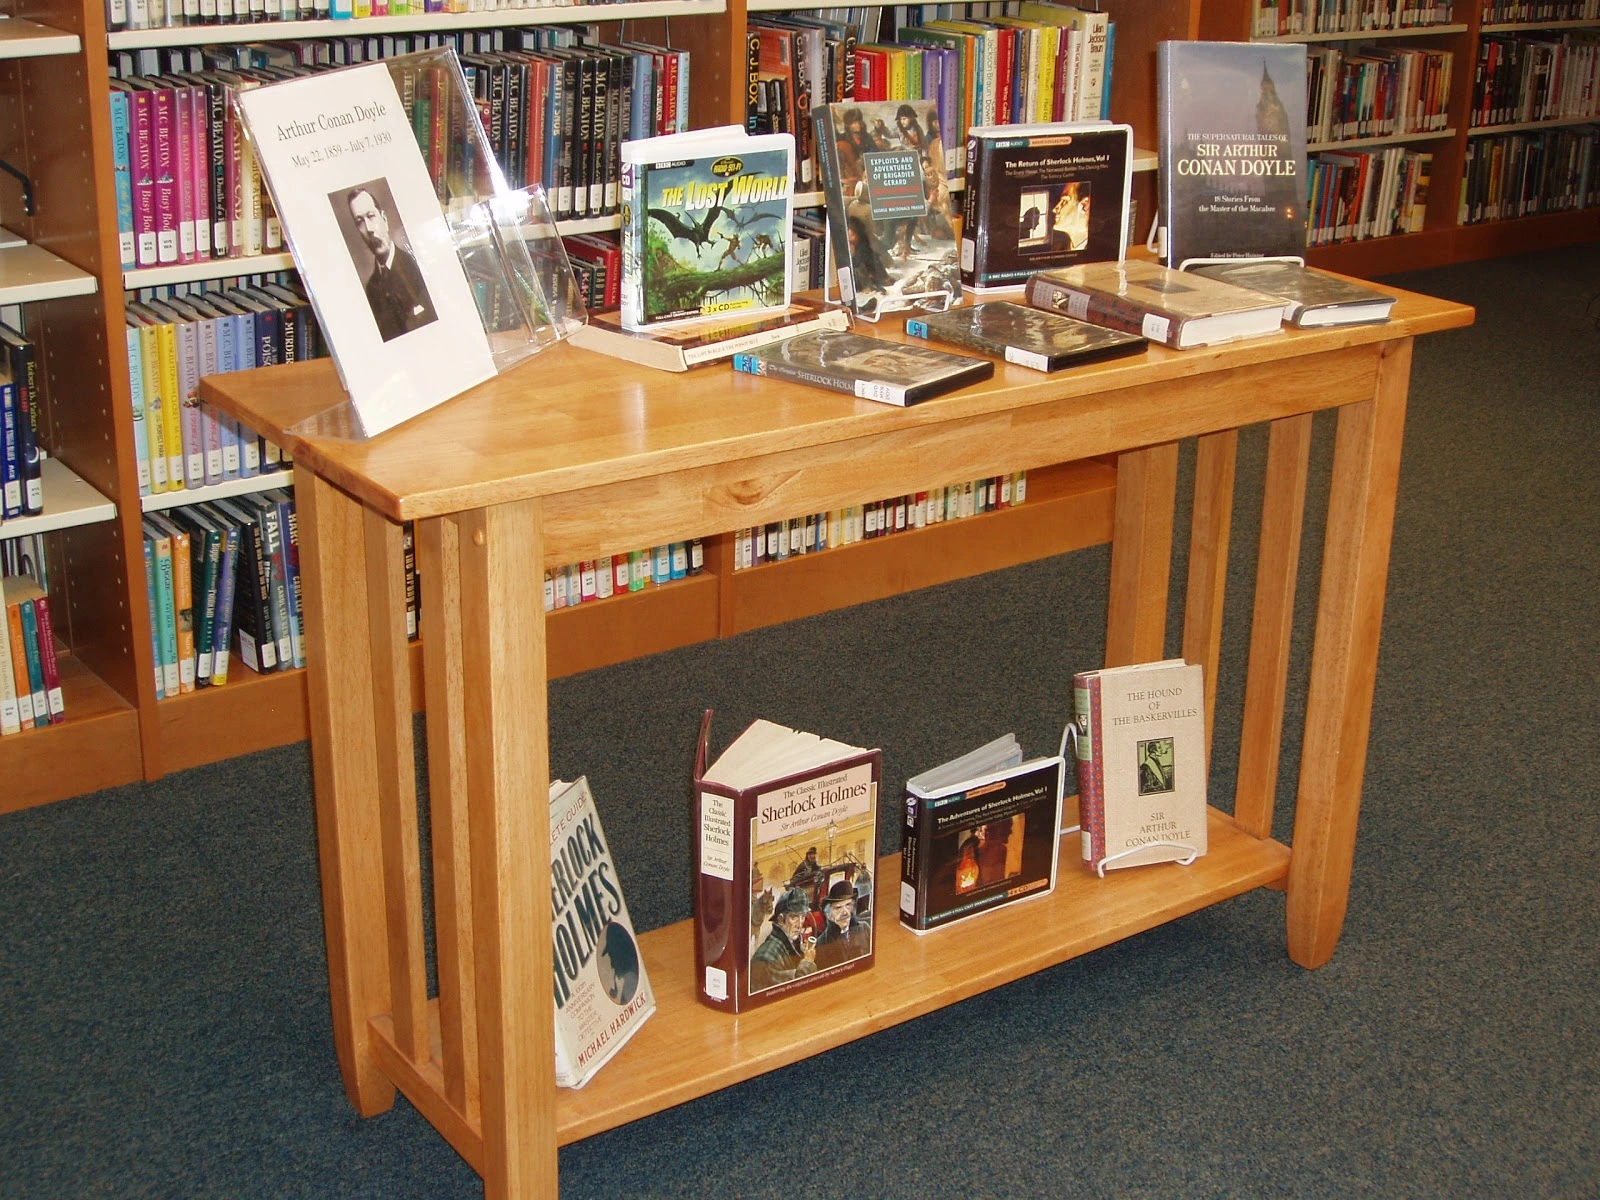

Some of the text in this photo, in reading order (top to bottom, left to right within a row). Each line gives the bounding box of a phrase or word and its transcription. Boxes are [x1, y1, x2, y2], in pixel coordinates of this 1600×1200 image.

[1091, 44, 1103, 52] Braun
[845, 37, 856, 92] C. J. BOX
[404, 75, 412, 109] DEATH
[748, 39, 759, 129] C. J. BOX In
[278, 102, 386, 141] Arthur Conan Doyle
[492, 99, 502, 141] BEATON
[508, 97, 518, 140] BEATON
[580, 97, 590, 140] BEATON
[594, 96, 606, 139] BEATON
[182, 135, 190, 172] BEATON
[213, 121, 224, 166] BEATON
[292, 132, 391, 167] May 22, 1859 July 7, 1930
[1197, 144, 1278, 157] SIR ARTHUR
[139, 130, 150, 213] BEATON Busy
[159, 128, 171, 211] BEATON Busy
[874, 164, 912, 172] ADVENTURES
[1047, 157, 1073, 165] Sherlock
[1073, 156, 1096, 164] Holmes,
[1178, 159, 1296, 176] CONAN DOYLE
[622, 175, 630, 185] CD
[884, 171, 915, 179] BRIGADIER
[199, 178, 207, 207] DEADLY
[662, 175, 788, 211] THE LOST WORLD
[596, 272, 605, 289] BAD
[718, 303, 730, 311] CD
[27, 362, 37, 389] Robert
[131, 365, 141, 400] BEATON
[150, 362, 160, 394] BEATON
[185, 356, 195, 391] BEATON
[797, 371, 832, 386] SHERLOCK
[833, 379, 854, 391] HOLM
[29, 392, 36, 400] B.
[265, 511, 280, 553] FALL
[210, 543, 220, 563] Biggie
[160, 559, 170, 591] BIGGIE
[292, 576, 302, 595] CAROL
[277, 585, 285, 607] CAROL
[1127, 687, 1182, 701] THE HOUND
[1148, 701, 1161, 710] OF
[1113, 708, 1197, 726] THE BASKERVILLES
[783, 774, 848, 799] The Classic Illustrated
[566, 792, 588, 822] GUIDE
[708, 807, 727, 817] Classic
[712, 799, 723, 808] The
[761, 782, 867, 824] Sherlock Holmes
[950, 807, 981, 821] Adventures
[988, 797, 1011, 809] Sherlock
[1013, 792, 1034, 802] Holmes,
[704, 815, 731, 827] Illustrated
[781, 805, 848, 831] Sir Arthur Conan Doyle
[1140, 822, 1177, 834] ARTHUR
[1151, 812, 1165, 821] SIR
[704, 824, 731, 836] Sherlock
[705, 834, 729, 846] Holmes
[1125, 830, 1191, 847] CONAN DOYLE
[552, 812, 605, 922] ERLOCK
[703, 861, 730, 872] Conan Doyle
[577, 992, 646, 1067] MICHAEL HARDWICK
